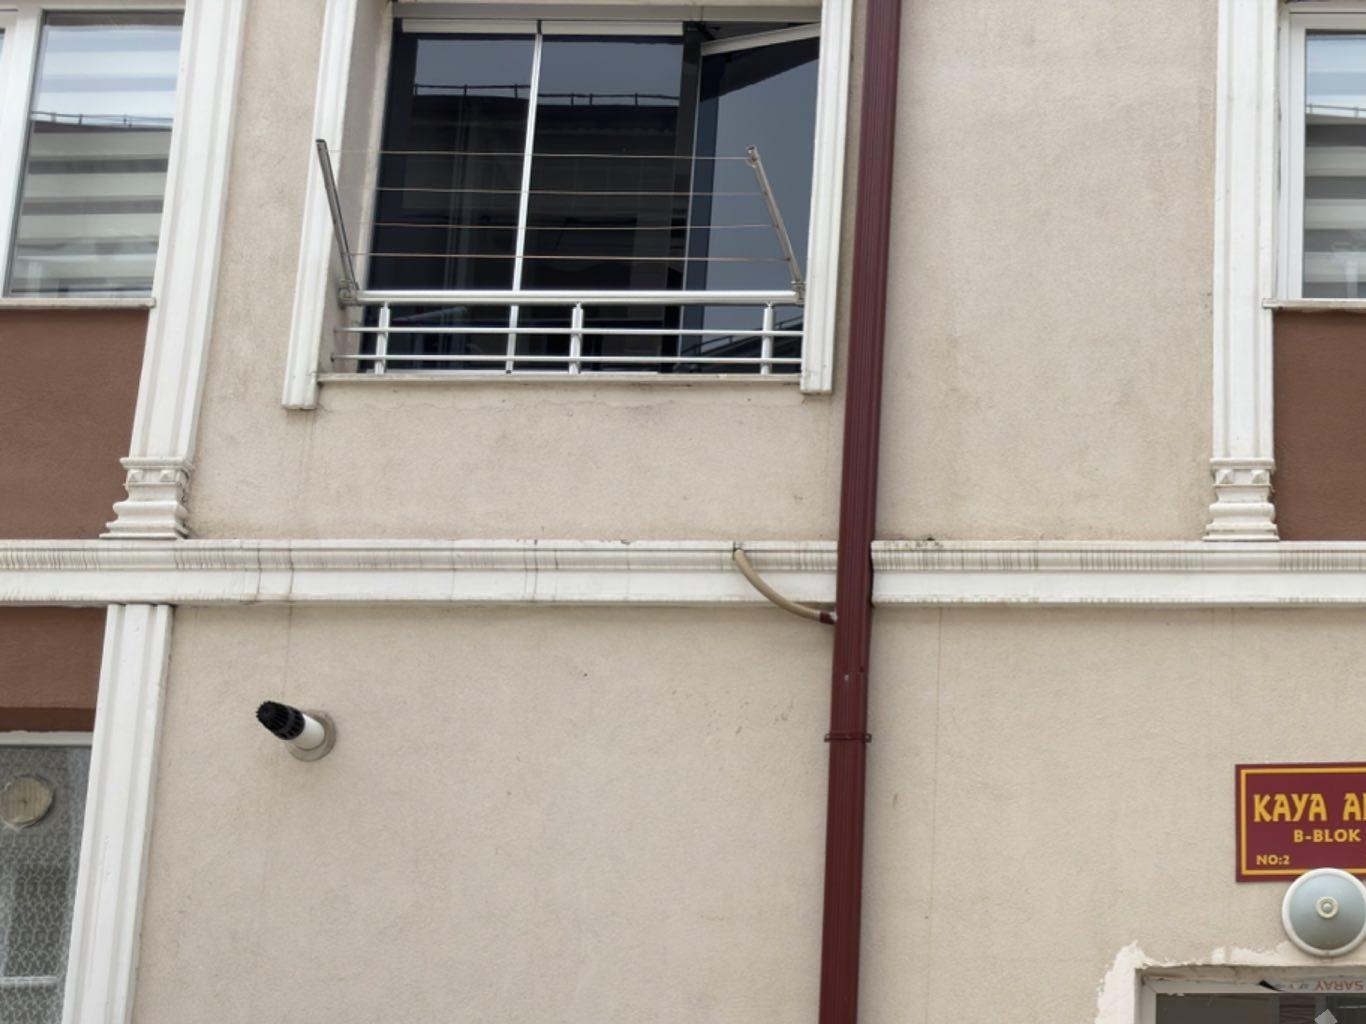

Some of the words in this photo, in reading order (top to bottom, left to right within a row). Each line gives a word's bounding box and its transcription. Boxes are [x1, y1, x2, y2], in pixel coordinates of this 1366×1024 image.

[1253, 793, 1328, 823] KAYA
[1293, 828, 1362, 843] B-BLOK
[1255, 854, 1291, 866] NO:2
[1313, 979, 1365, 992] SARAY
